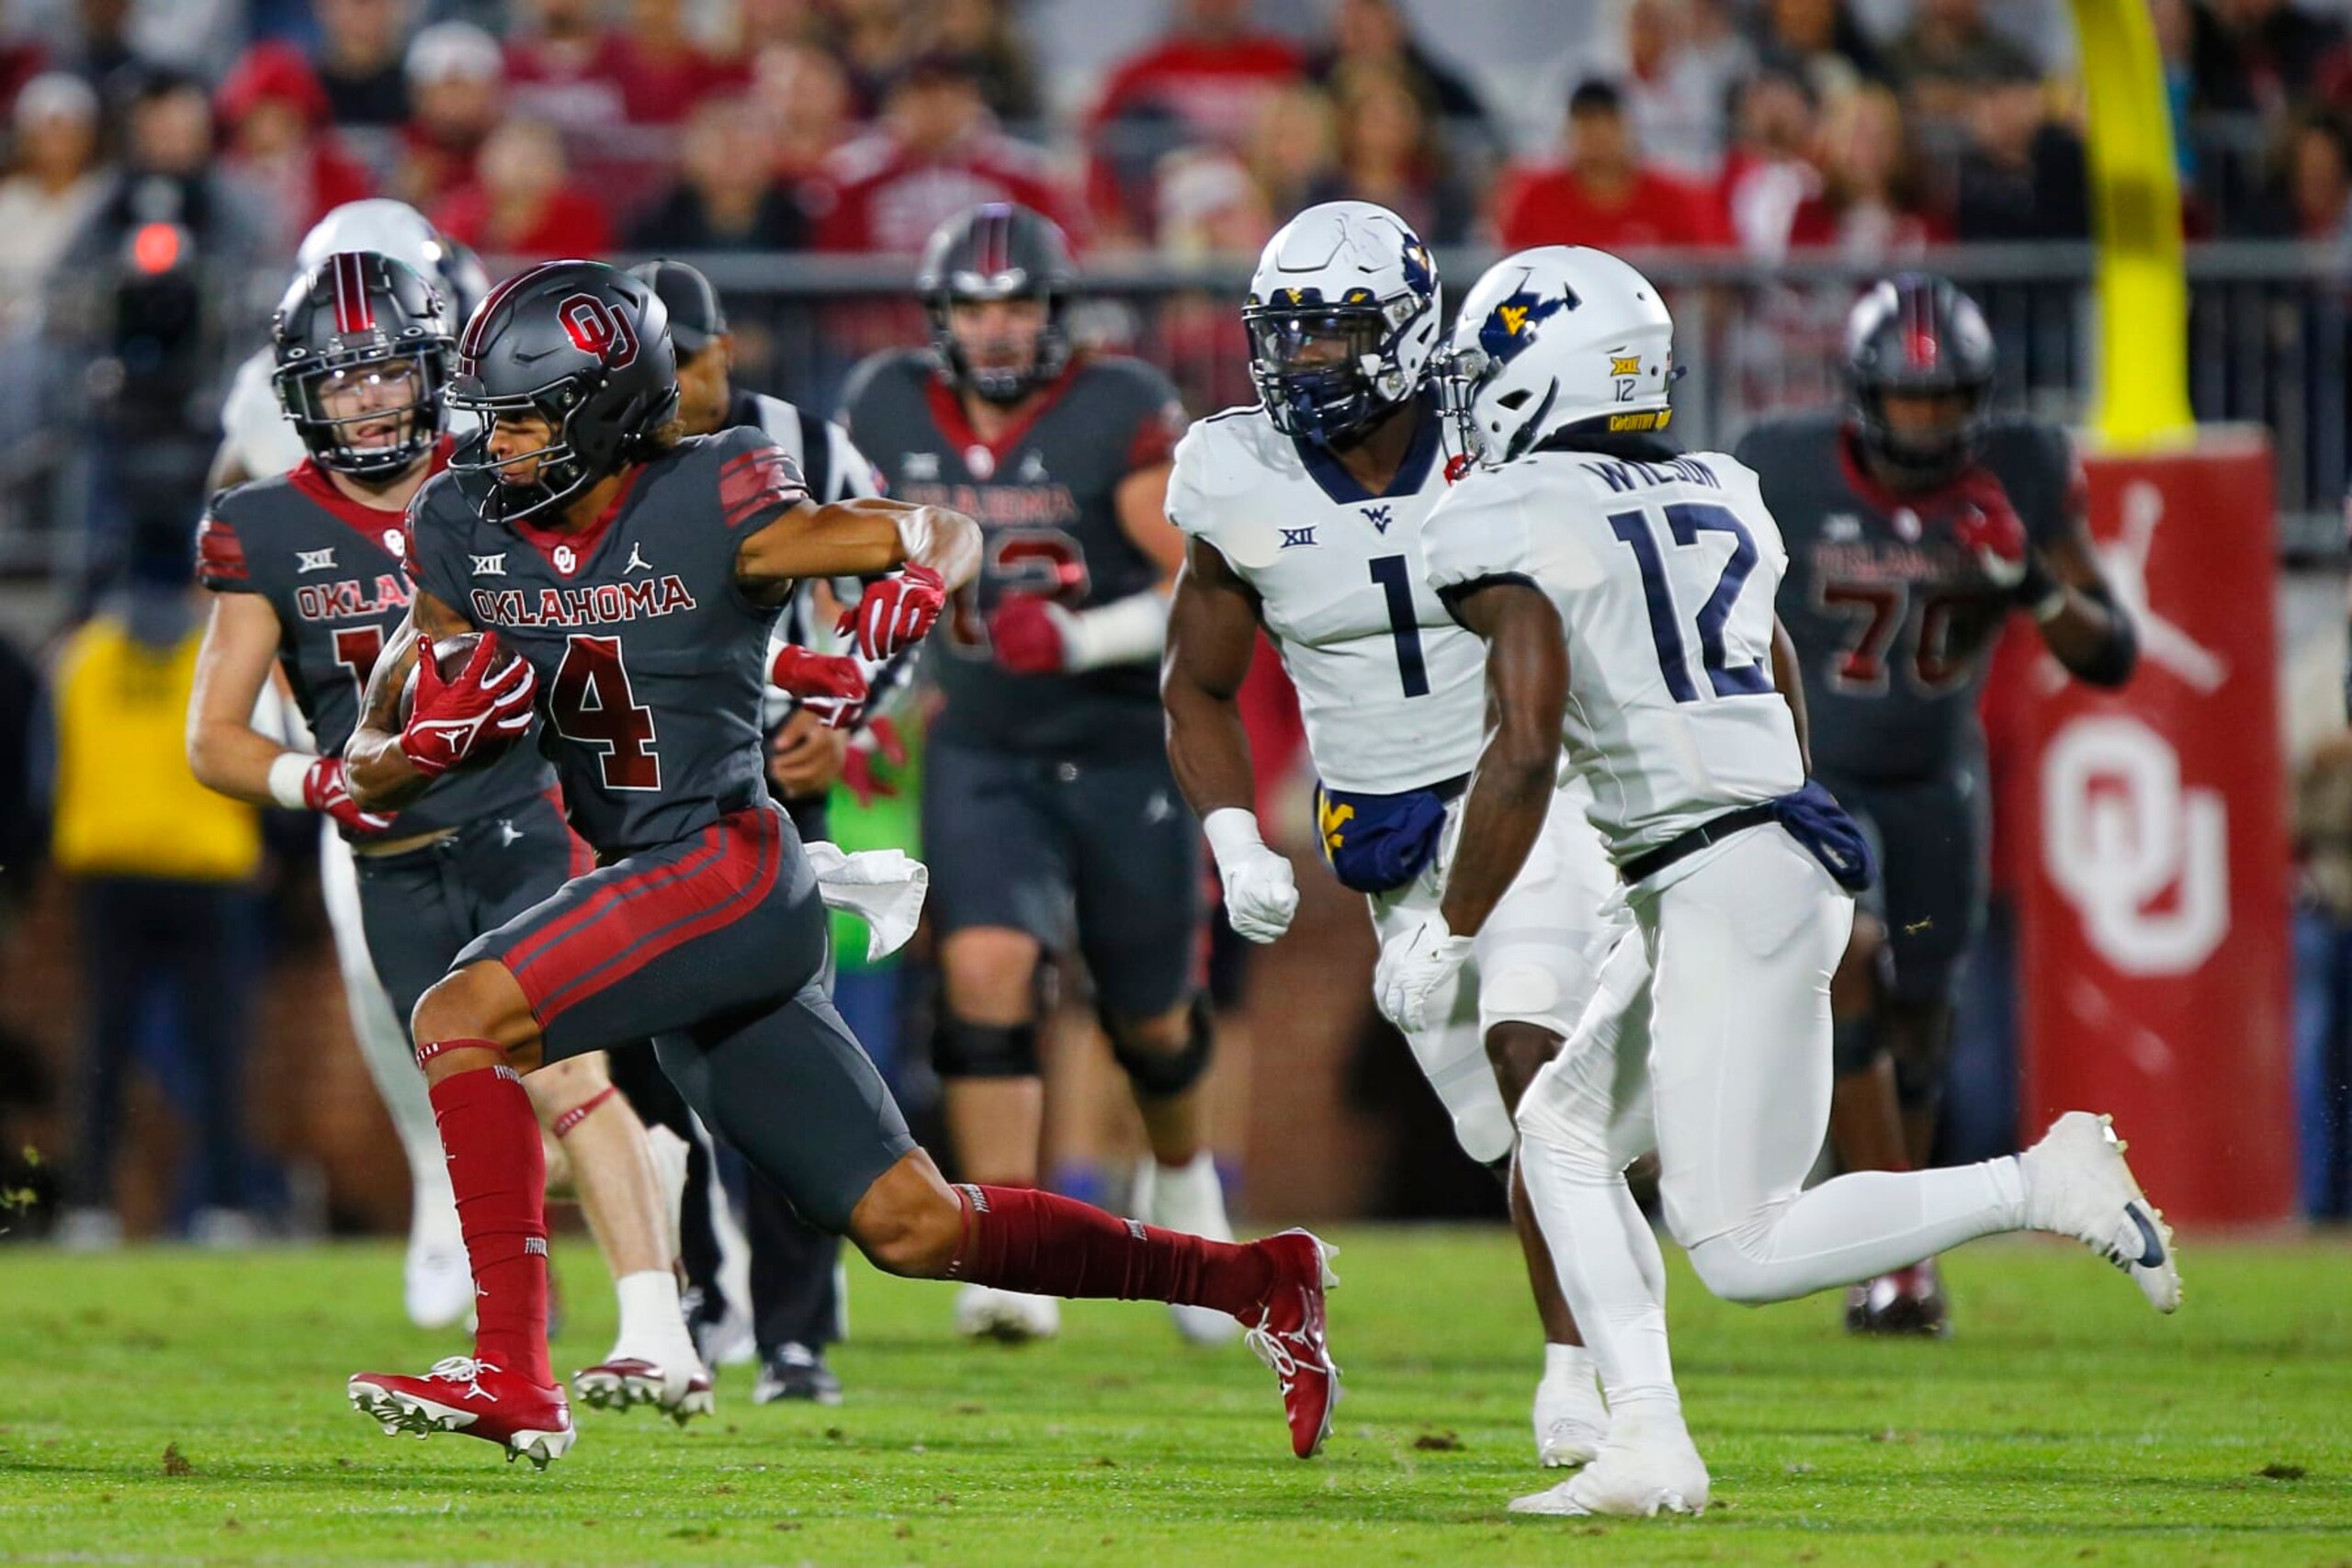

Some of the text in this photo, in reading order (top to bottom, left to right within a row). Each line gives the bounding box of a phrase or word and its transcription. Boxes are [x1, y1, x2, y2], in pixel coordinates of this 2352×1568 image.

[557, 292, 640, 372] OU
[1615, 378, 1635, 402] 12
[1578, 457, 1722, 493] WILSON
[295, 547, 339, 574] XII
[553, 546, 576, 574] OU
[1278, 525, 1318, 548] XII
[468, 552, 507, 576] XII
[297, 574, 411, 622] OKLA
[470, 574, 696, 627] OKLAHOMA
[1607, 502, 1777, 704] 12
[1368, 554, 1430, 698] 1
[548, 634, 662, 792] 4
[2041, 715, 2231, 978] OU
